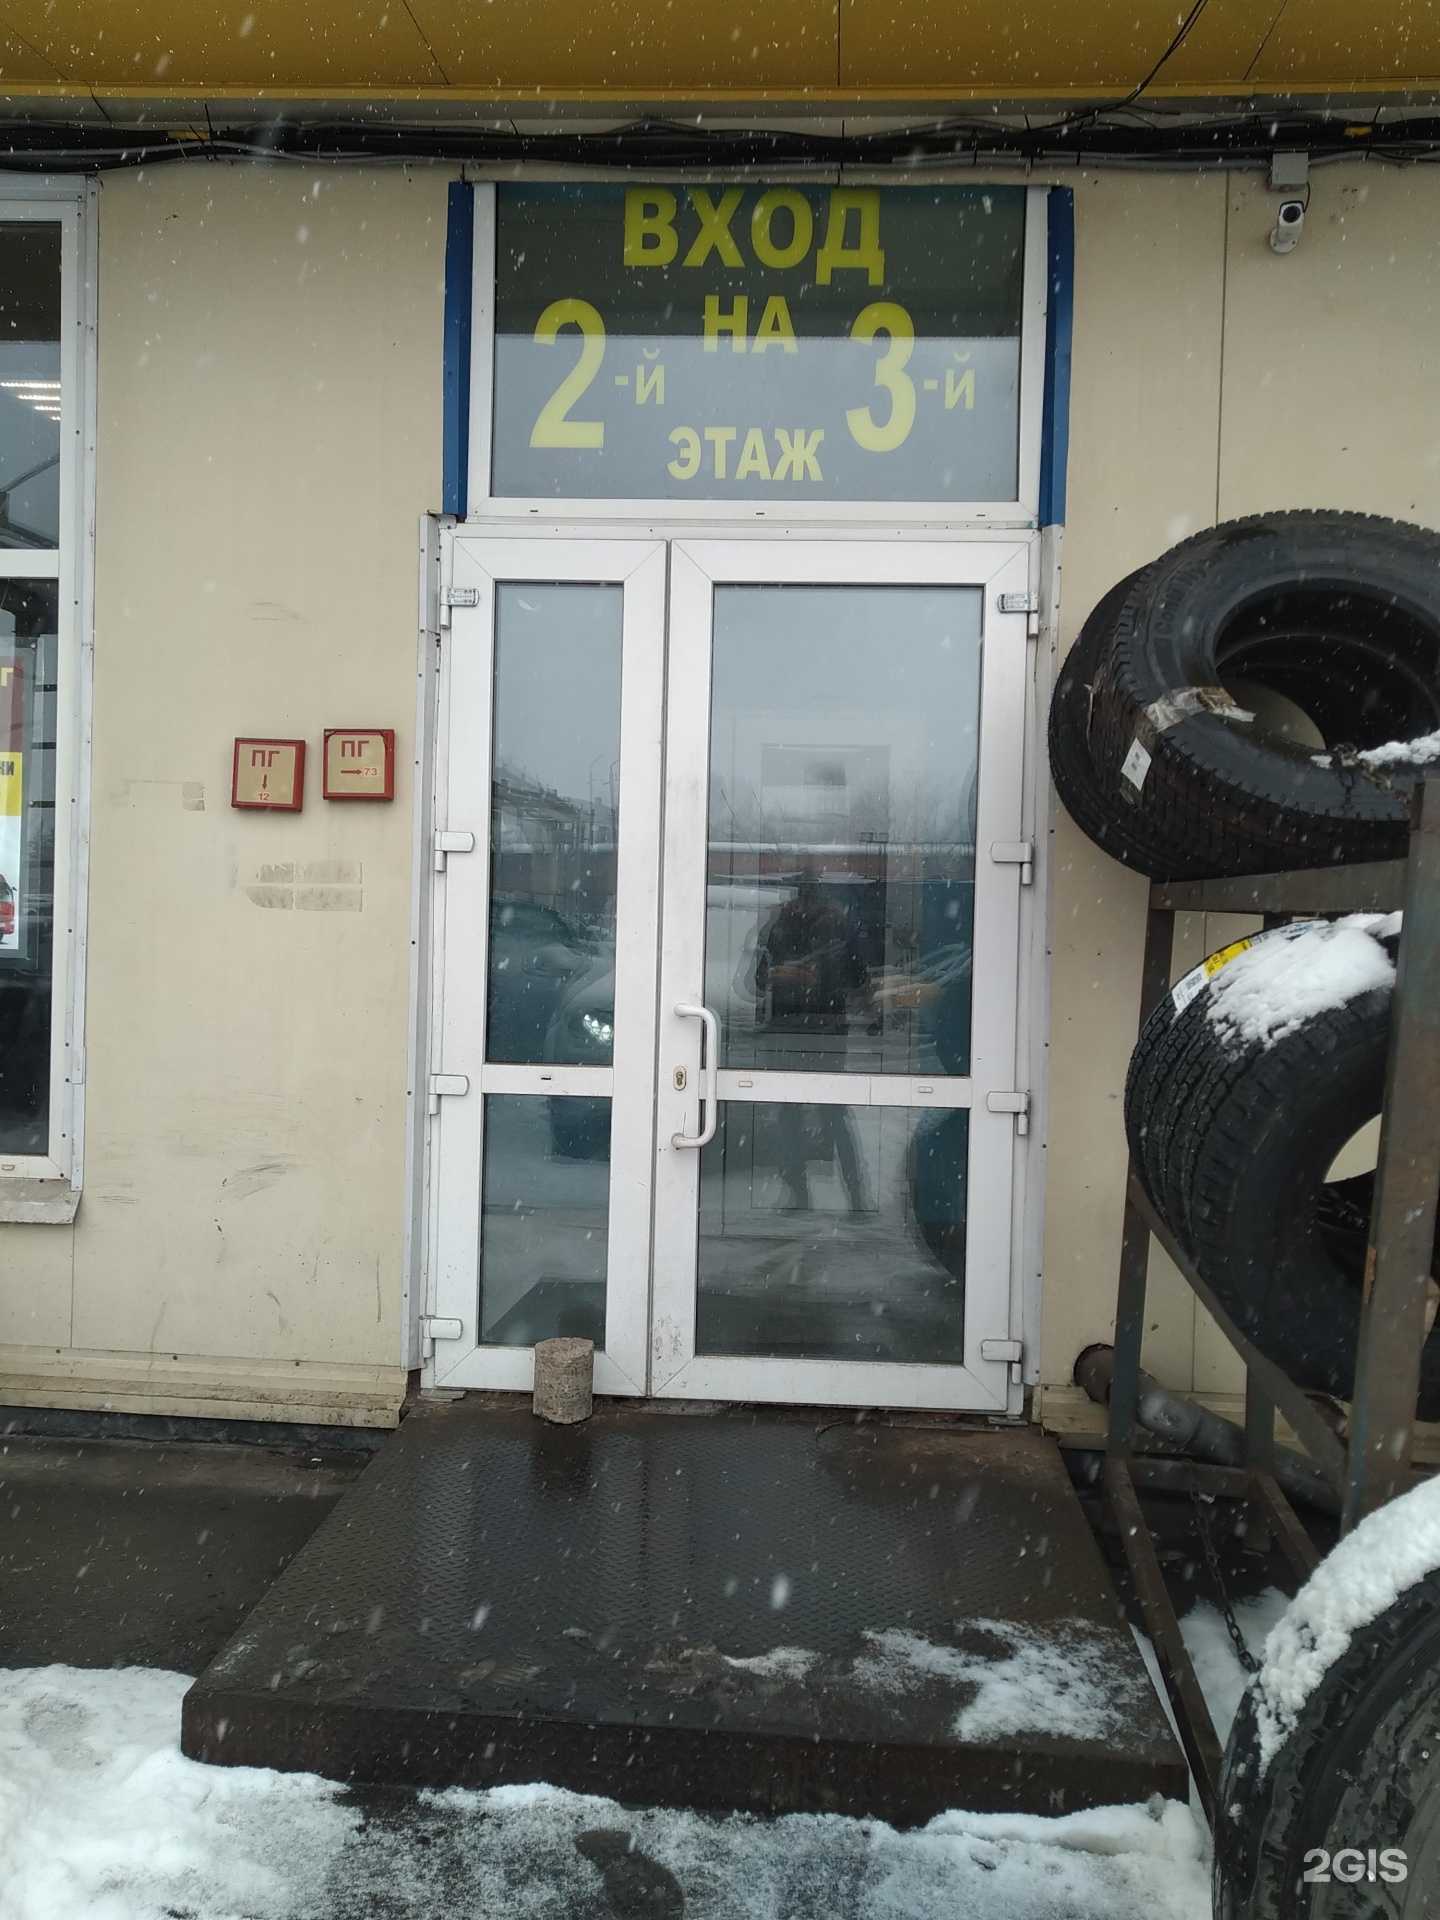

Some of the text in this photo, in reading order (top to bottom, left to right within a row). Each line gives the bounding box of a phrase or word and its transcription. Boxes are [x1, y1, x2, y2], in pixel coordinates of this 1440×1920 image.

[624, 188, 885, 287] ВХОД
[703, 295, 799, 354] НА
[666, 426, 825, 482] ЭТАЖ
[251, 749, 280, 767] ПГ
[341, 740, 369, 757] ПГ
